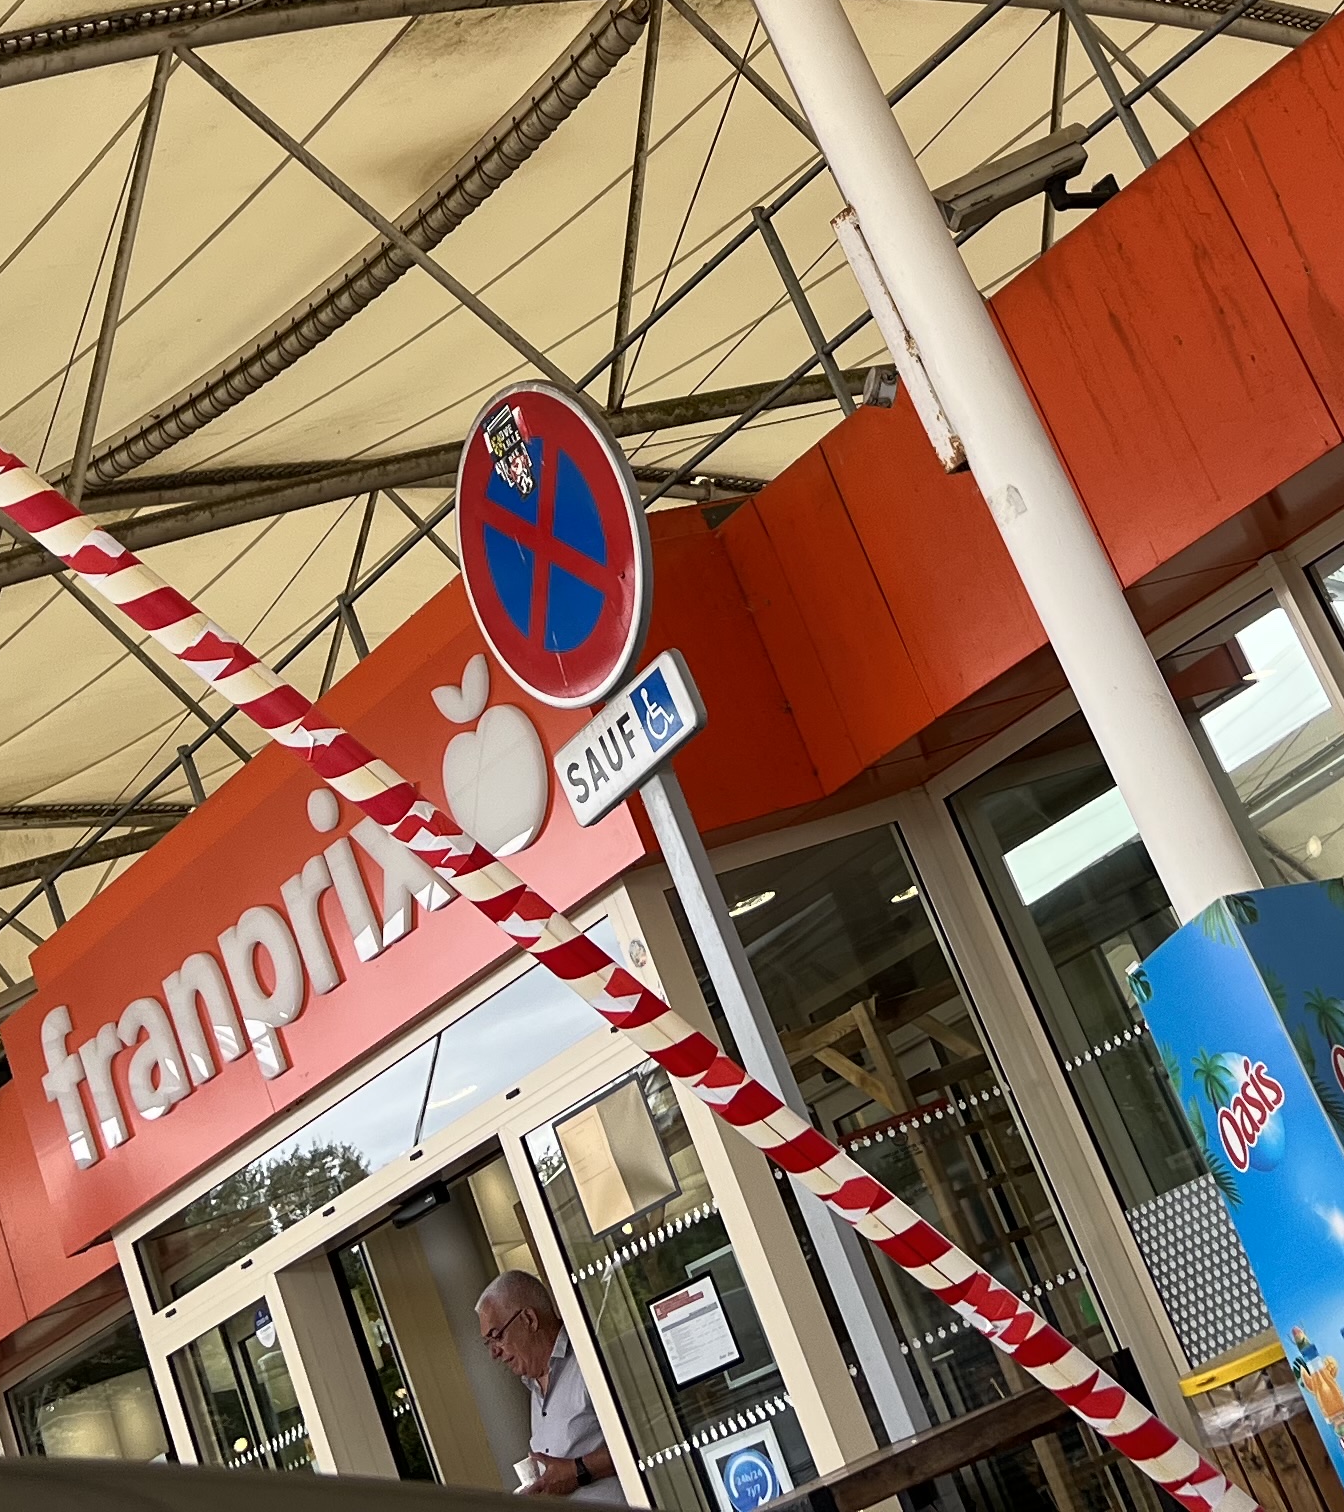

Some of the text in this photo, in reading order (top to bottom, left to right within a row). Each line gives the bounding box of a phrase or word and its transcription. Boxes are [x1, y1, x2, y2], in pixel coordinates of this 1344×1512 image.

[567, 711, 636, 804] SAUF
[41, 787, 456, 1170] franprix
[1218, 1058, 1284, 1171] Oasis
